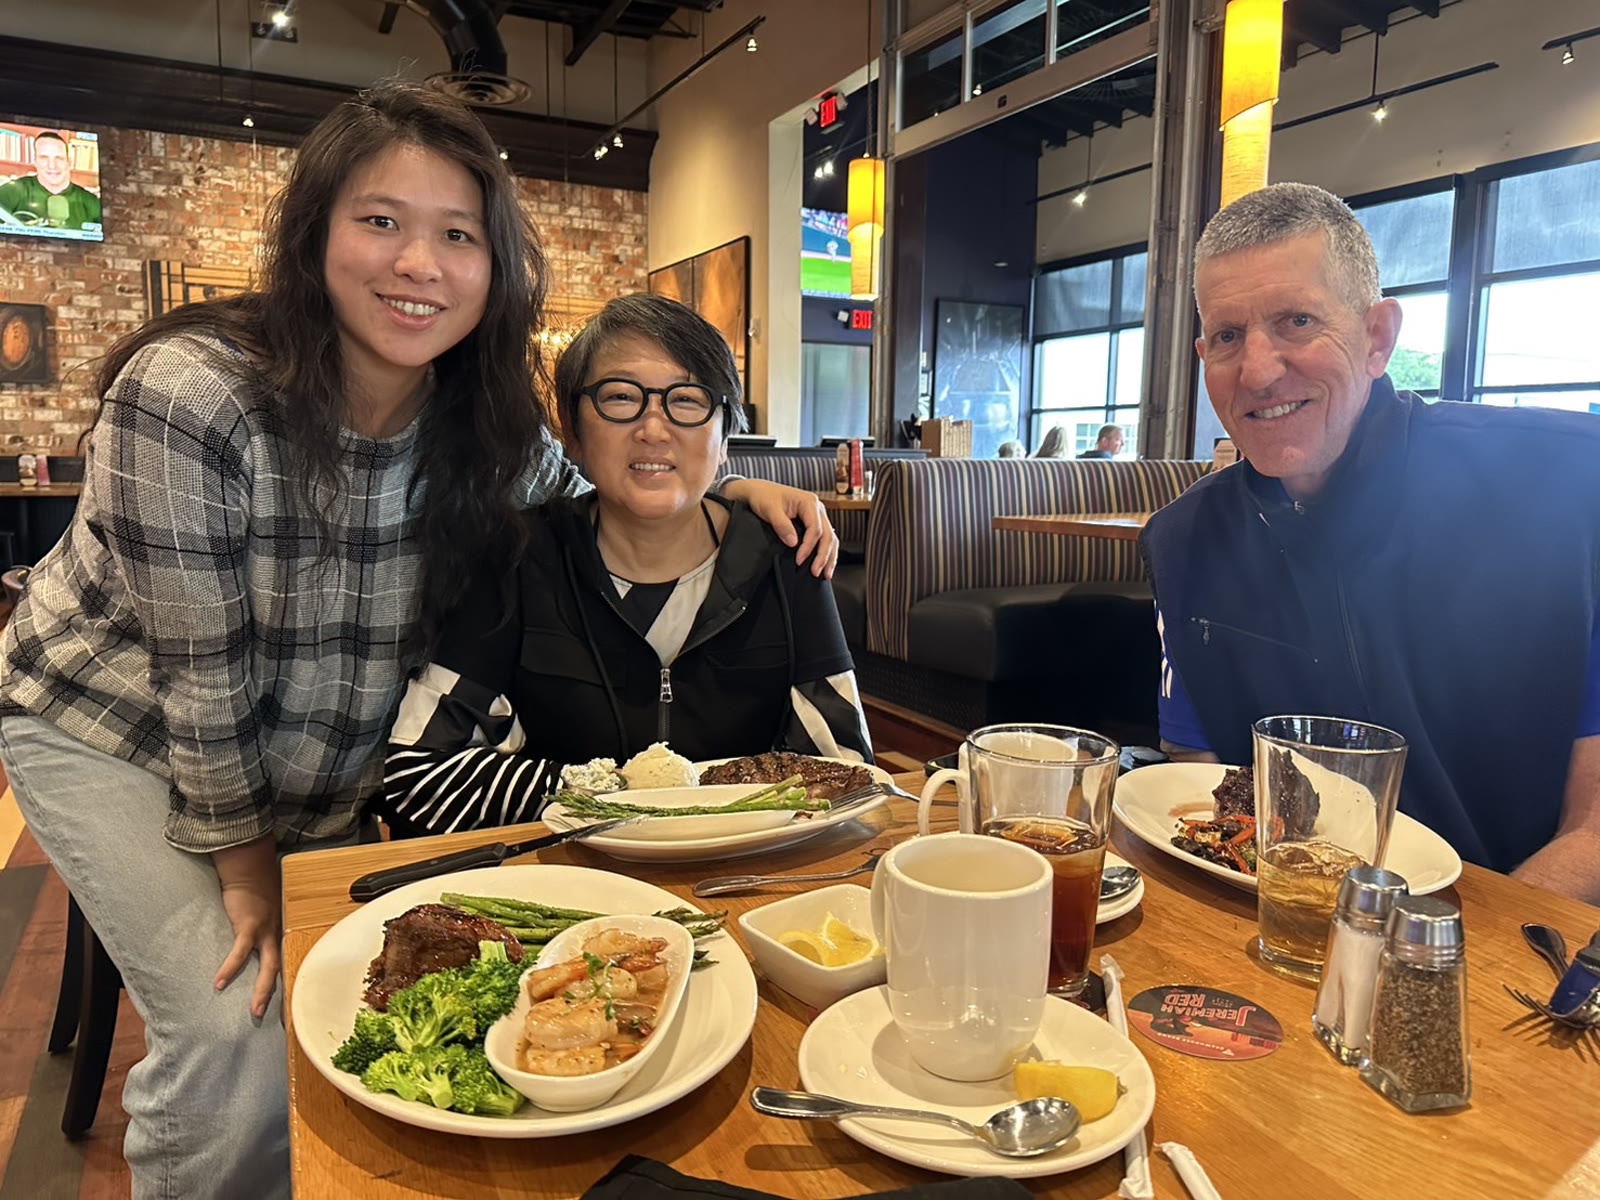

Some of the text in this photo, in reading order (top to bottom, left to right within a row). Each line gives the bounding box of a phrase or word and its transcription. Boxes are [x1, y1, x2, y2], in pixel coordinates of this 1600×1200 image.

[821, 96, 836, 127] EXIT
[852, 309, 873, 329] EXIT
[1164, 993, 1206, 1007] RED
[1160, 1004, 1256, 1027] JEREMIAH
